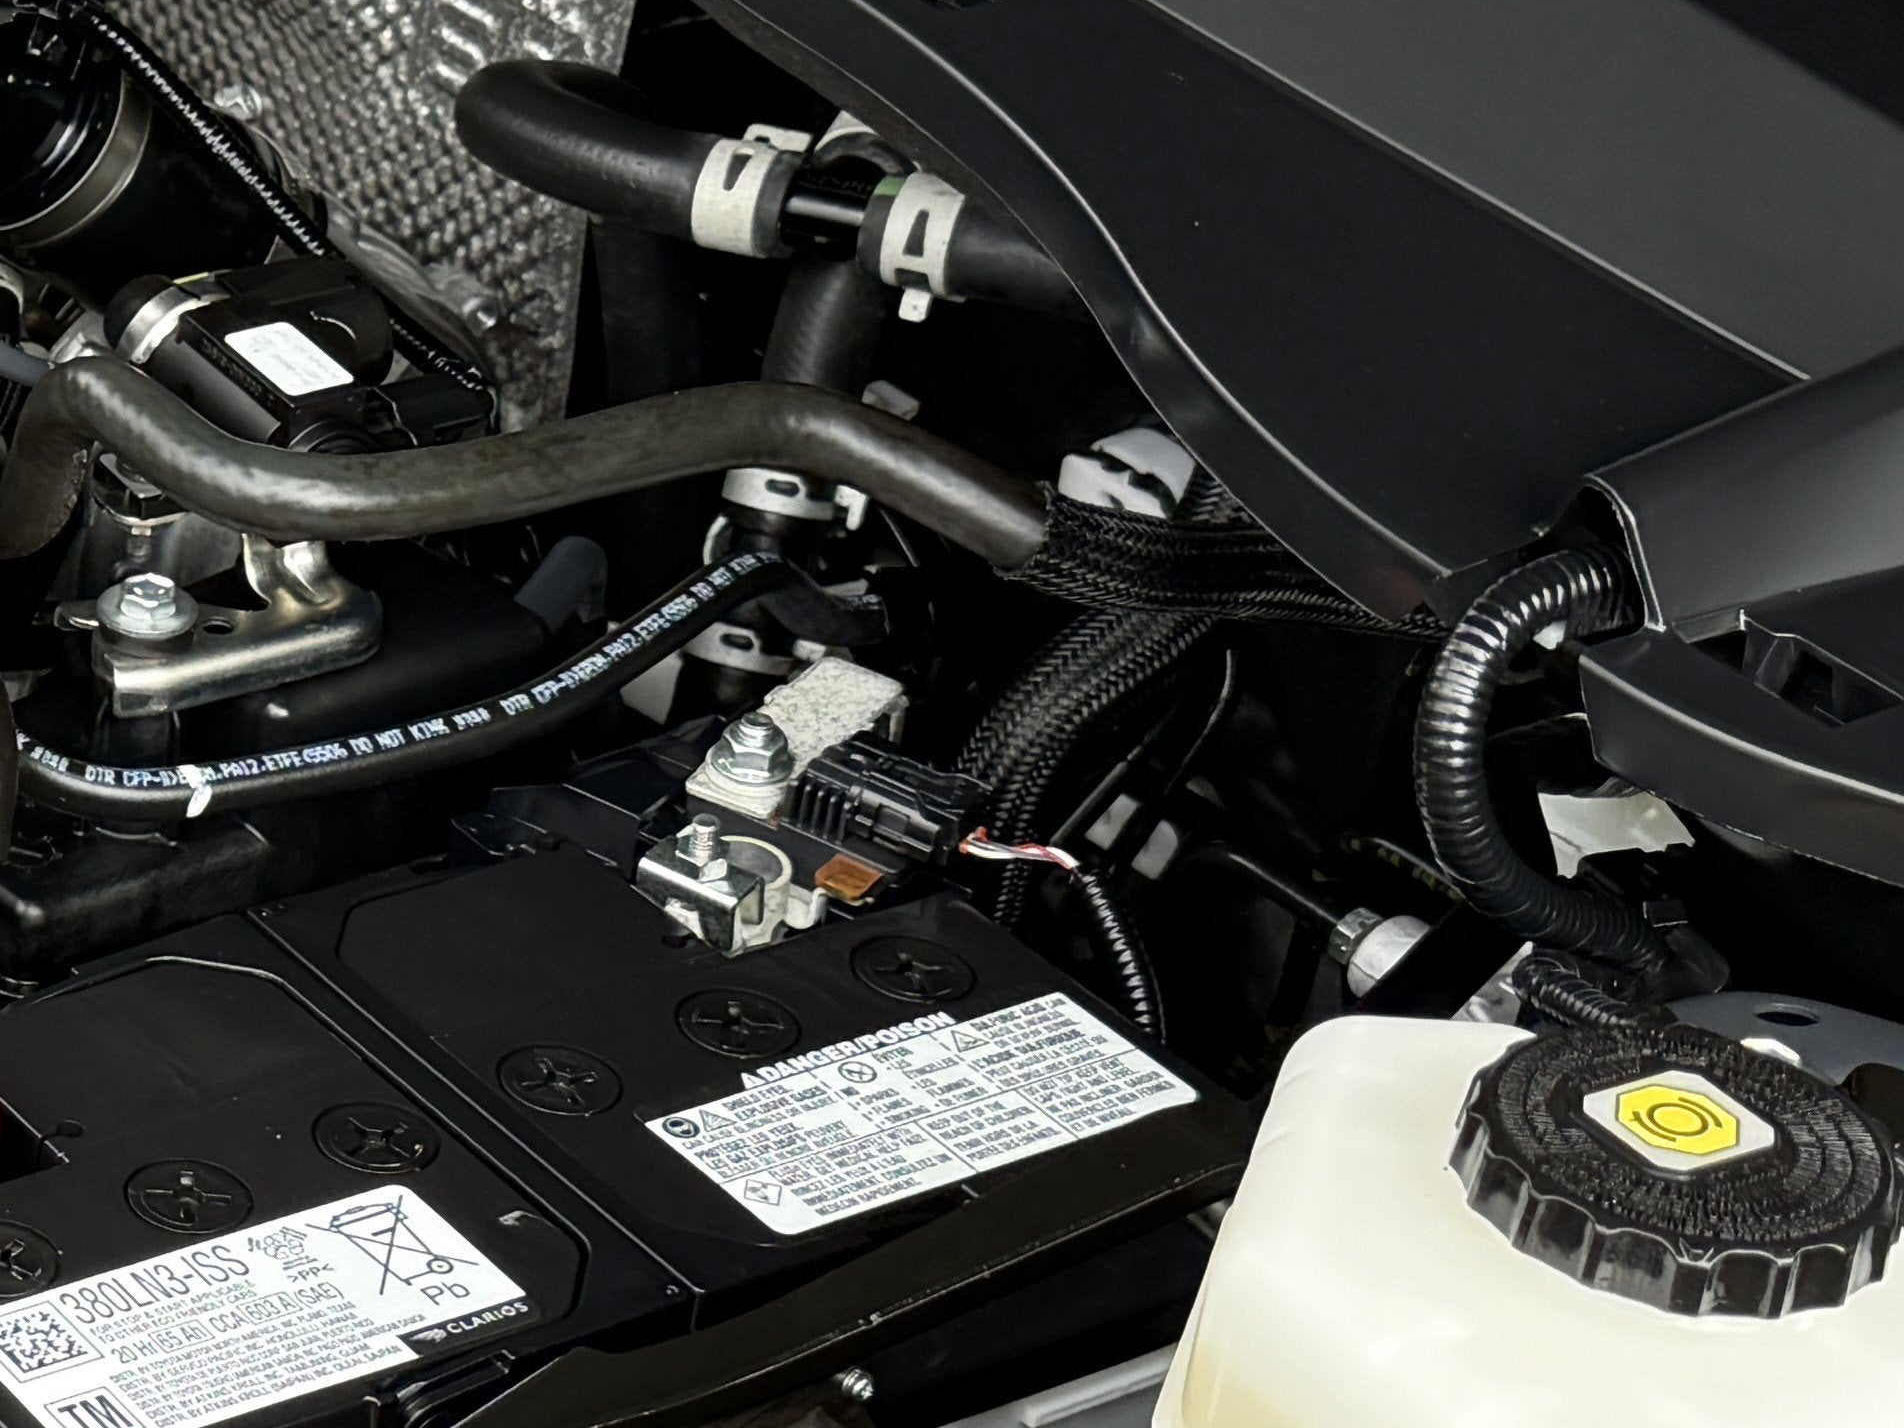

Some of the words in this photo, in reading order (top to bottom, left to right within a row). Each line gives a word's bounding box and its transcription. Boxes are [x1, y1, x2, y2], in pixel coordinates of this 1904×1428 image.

[762, 1010, 957, 1079] DANGER/POISON
[59, 1244, 250, 1325] 380LN3-ISS
[420, 1281, 471, 1306] Pb
[440, 1298, 535, 1337] CLARIOS
[110, 1345, 138, 1365] 20
[132, 1340, 158, 1357] Hr
[155, 1330, 184, 1349] 65
[179, 1325, 207, 1342] Ah
[208, 1311, 249, 1333] CCA
[244, 1299, 281, 1321] 603
[277, 1295, 296, 1311] A
[293, 1281, 344, 1308] (SAE)
